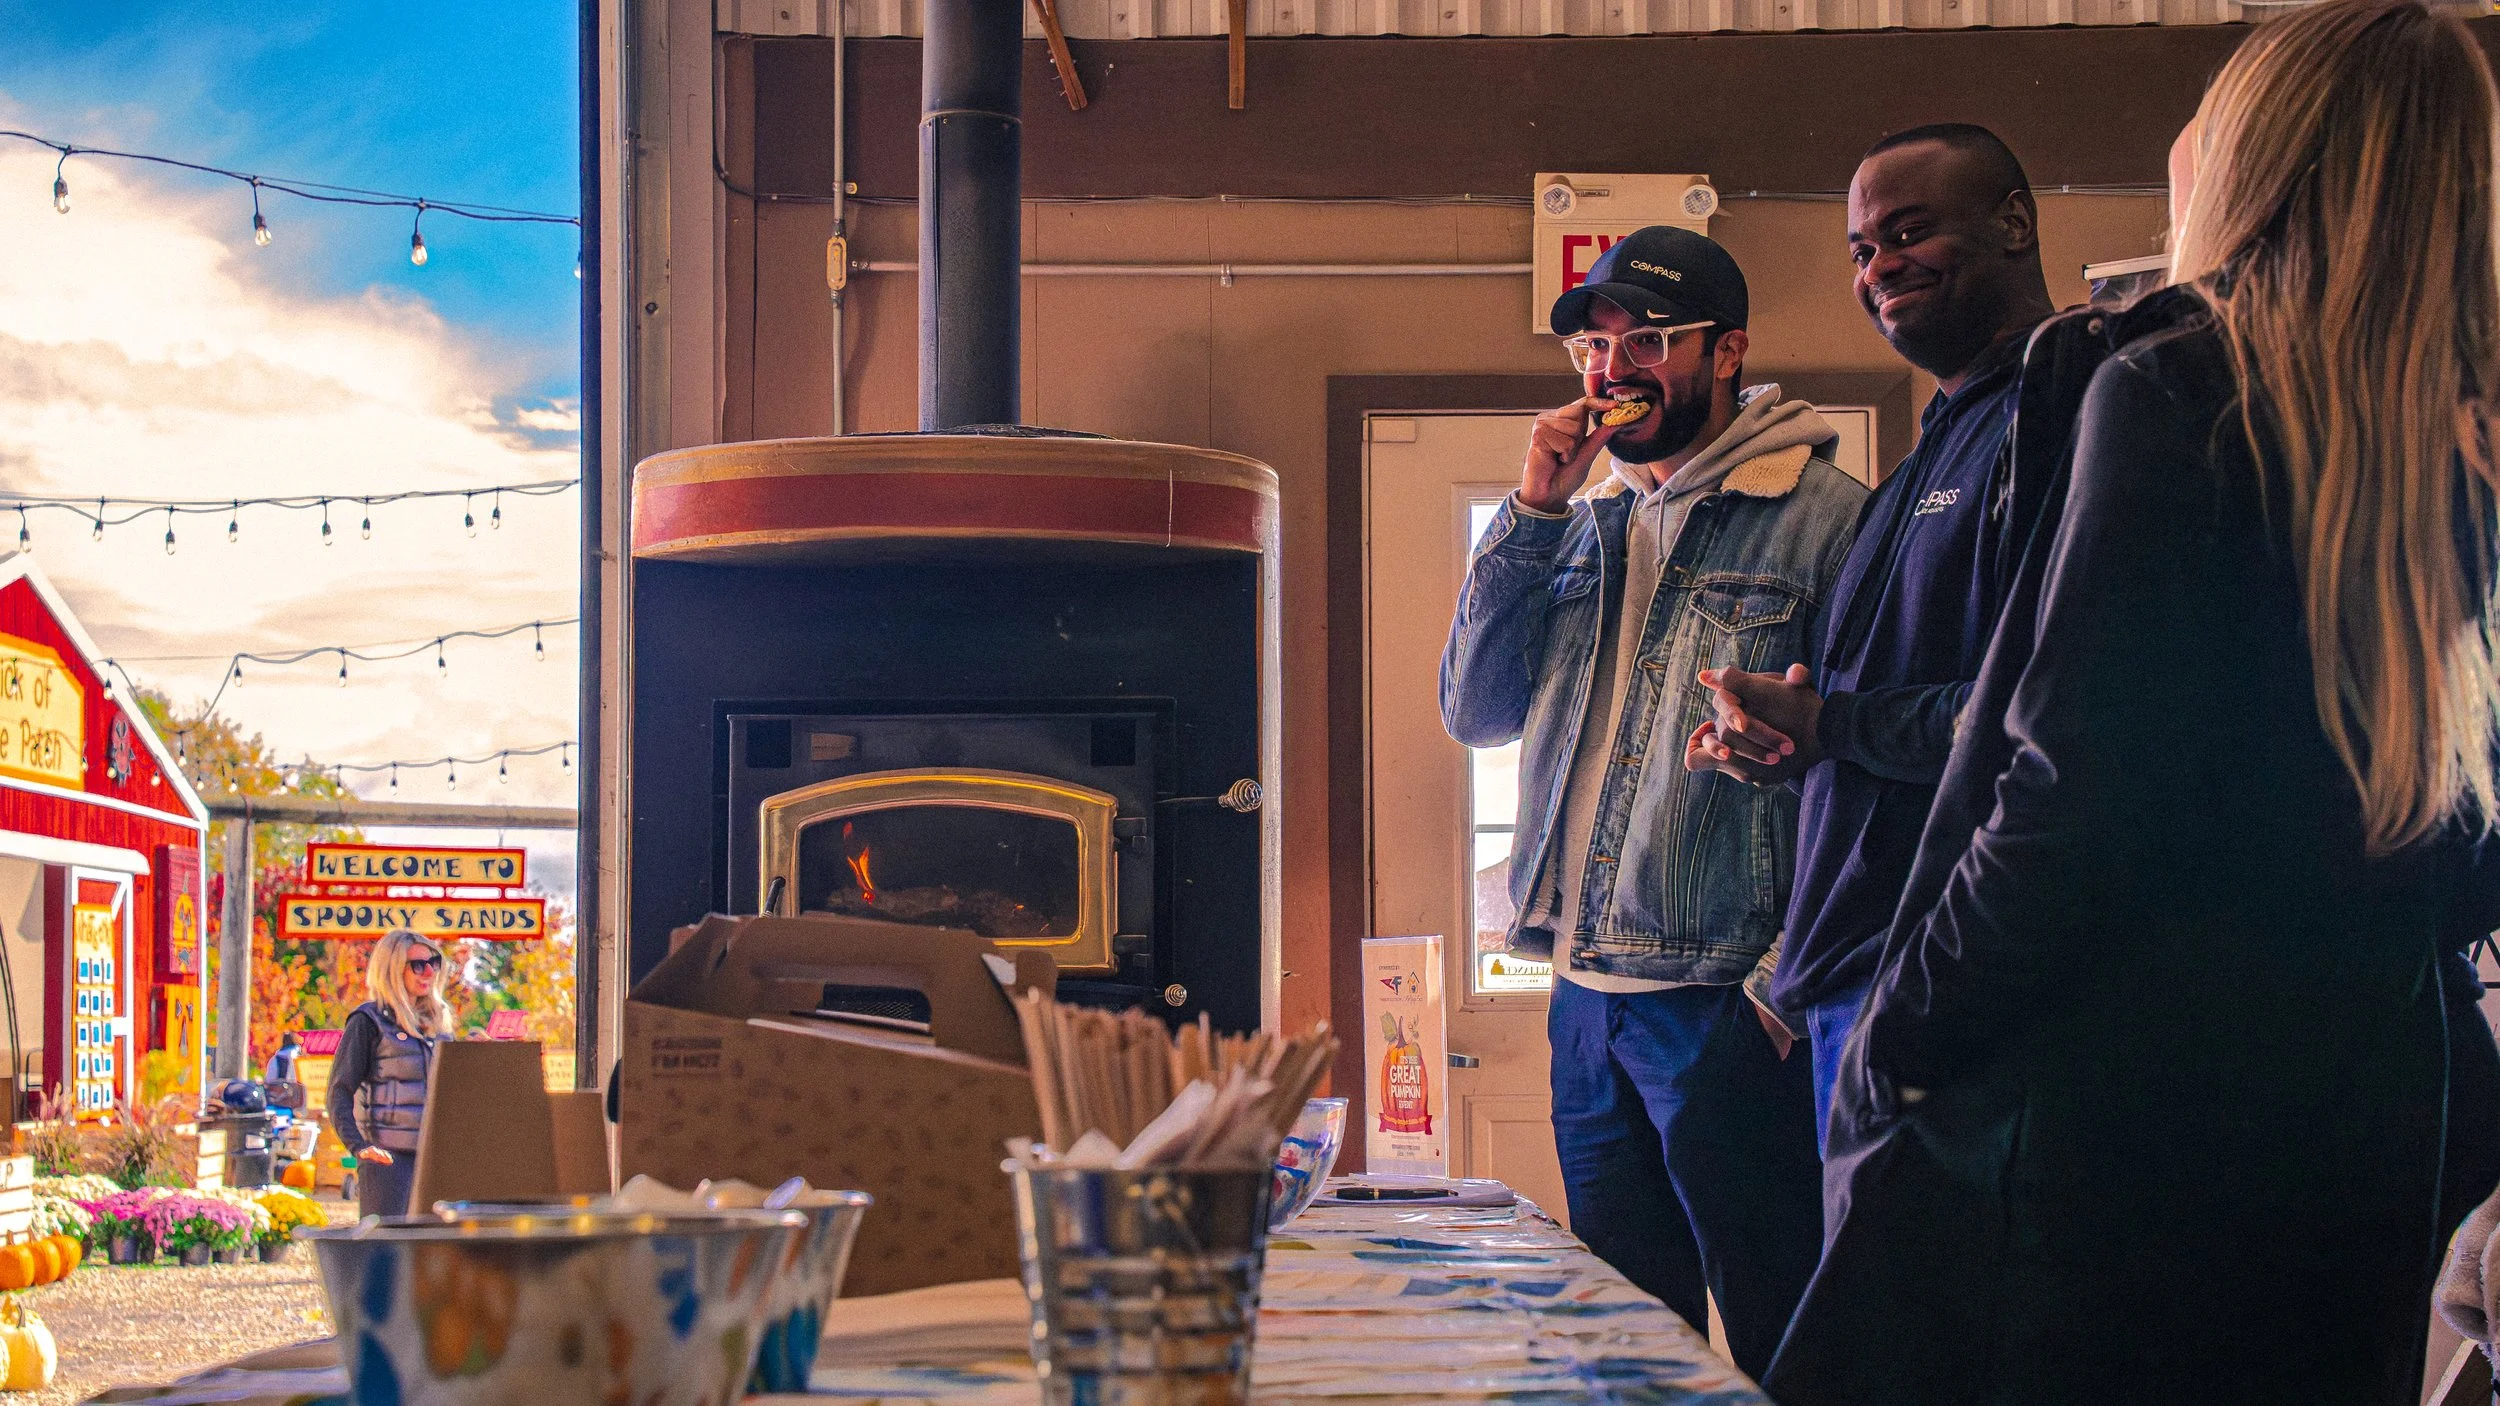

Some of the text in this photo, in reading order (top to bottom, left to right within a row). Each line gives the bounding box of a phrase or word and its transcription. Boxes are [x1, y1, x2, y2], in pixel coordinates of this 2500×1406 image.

[1630, 260, 1682, 282] COMPASS
[1915, 488, 1960, 516] CPASS
[34, 668, 53, 709] of
[20, 718, 62, 770] Patch
[318, 854, 515, 879] WELCOME TO
[293, 905, 536, 930] SPOOKY SANDS
[1390, 1064, 1421, 1084] GREAT
[1391, 1084, 1421, 1099] PUMPKIN
